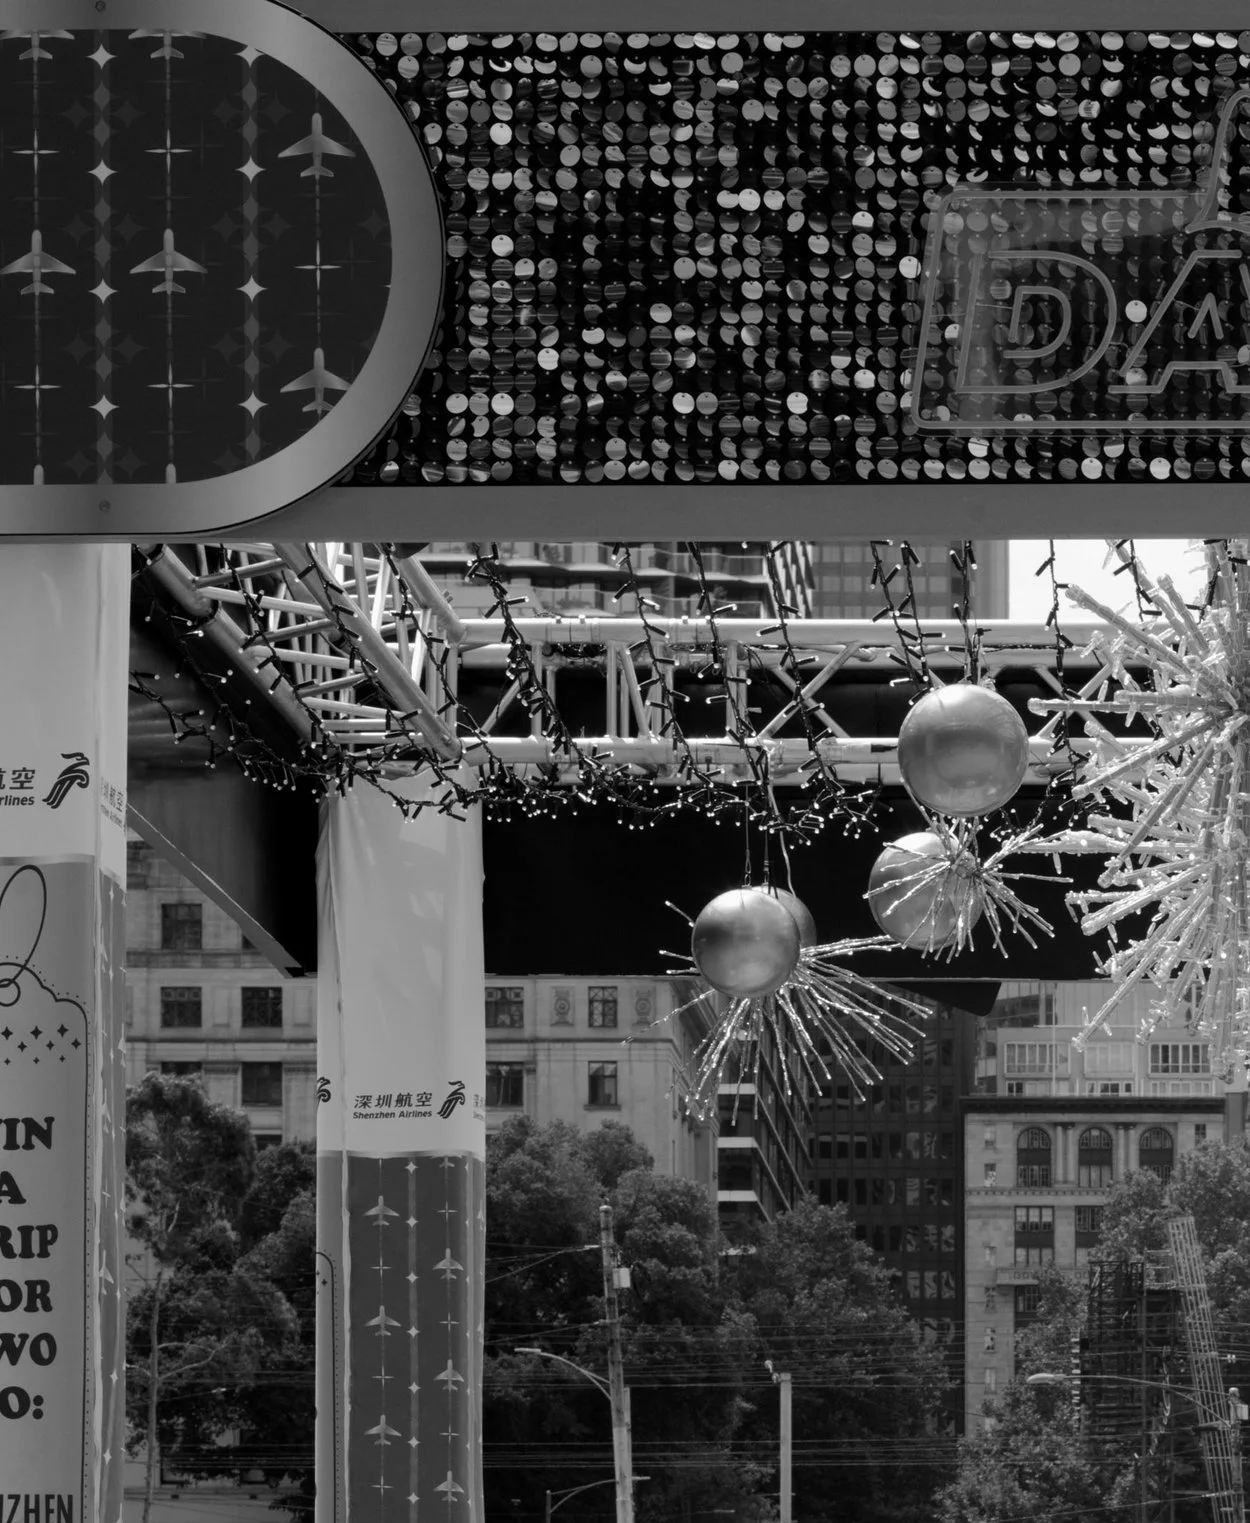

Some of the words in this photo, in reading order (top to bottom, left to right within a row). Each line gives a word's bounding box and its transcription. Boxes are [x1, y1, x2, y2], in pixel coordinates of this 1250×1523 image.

[354, 1092, 433, 1109] 深圳航空
[353, 1111, 395, 1120] Shenzhen
[398, 1110, 432, 1119] Airlines
[0, 1116, 55, 1150] IN
